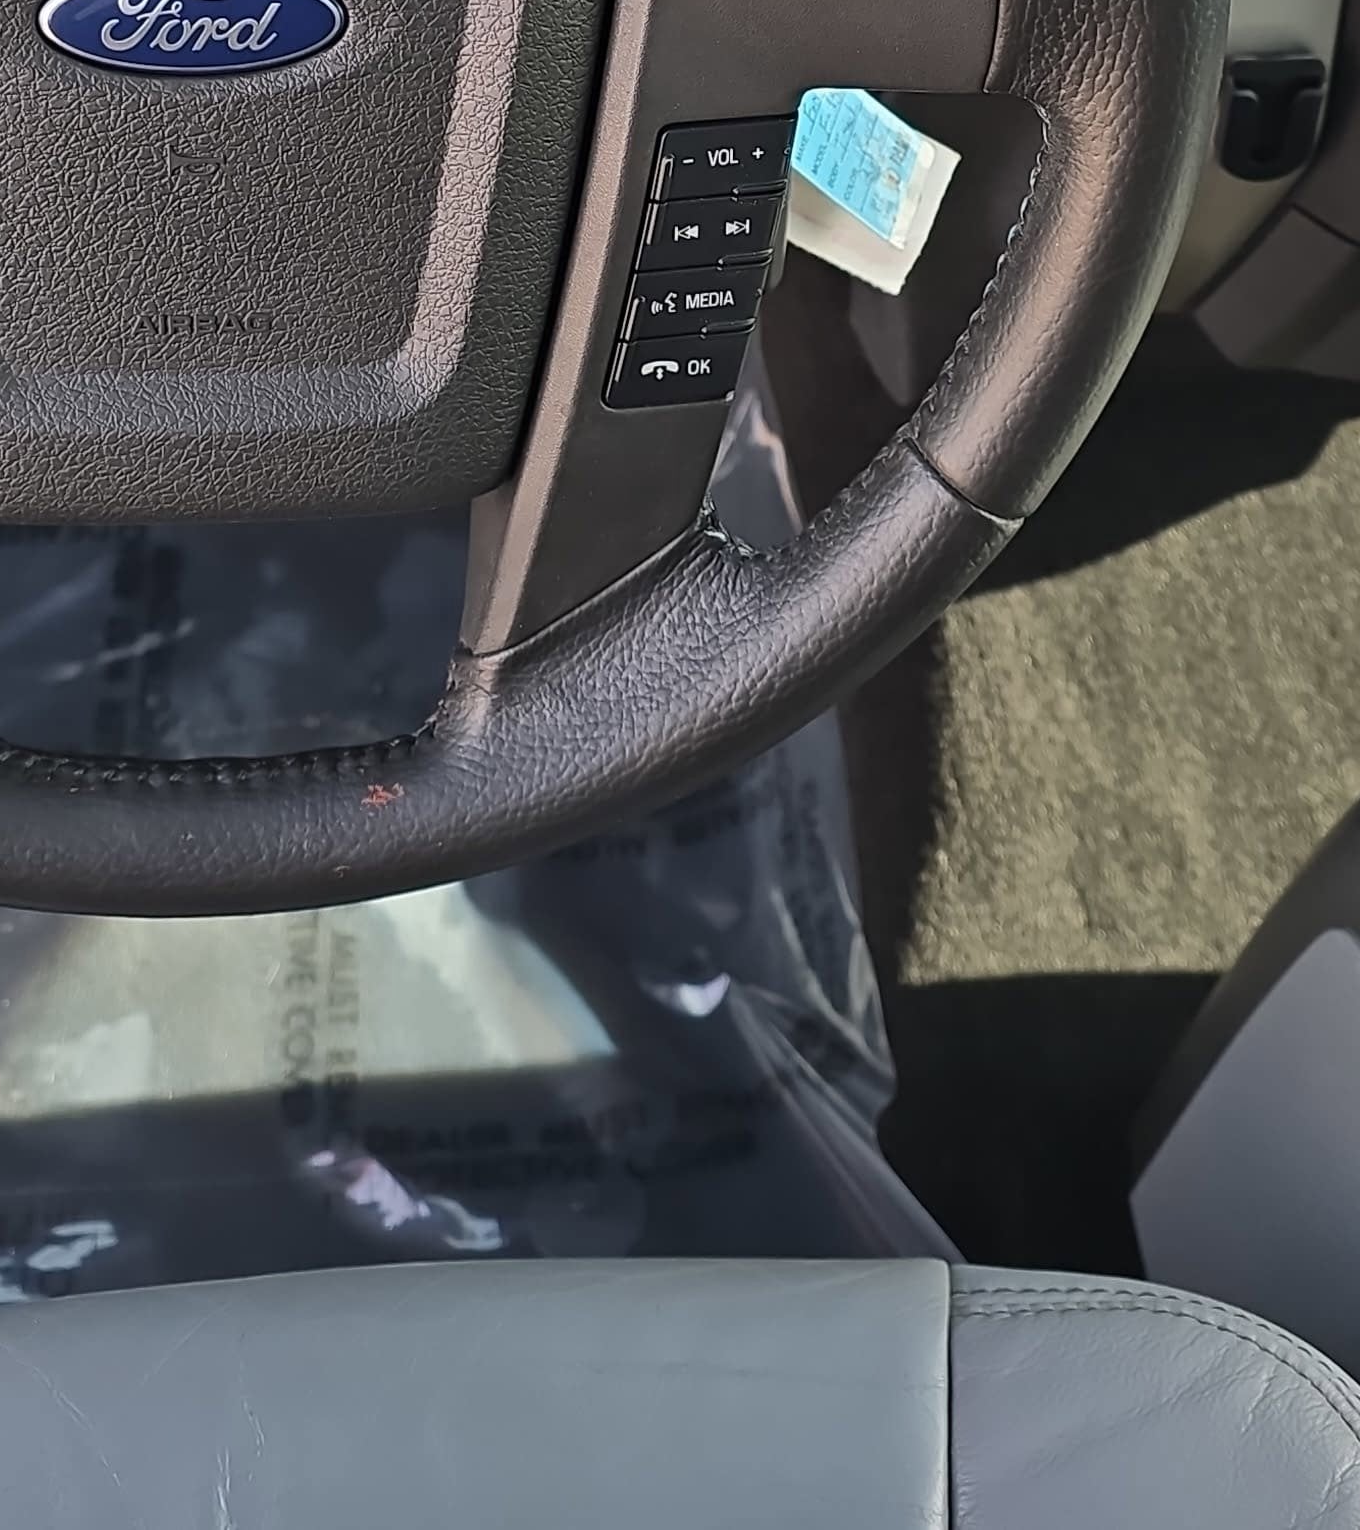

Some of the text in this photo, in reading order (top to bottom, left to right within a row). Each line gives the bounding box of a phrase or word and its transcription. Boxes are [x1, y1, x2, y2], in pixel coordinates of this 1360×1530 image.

[707, 148, 738, 167] VOL
[685, 290, 734, 310] MEDIA
[131, 310, 272, 335] AIRBAG
[688, 359, 711, 375] OK
